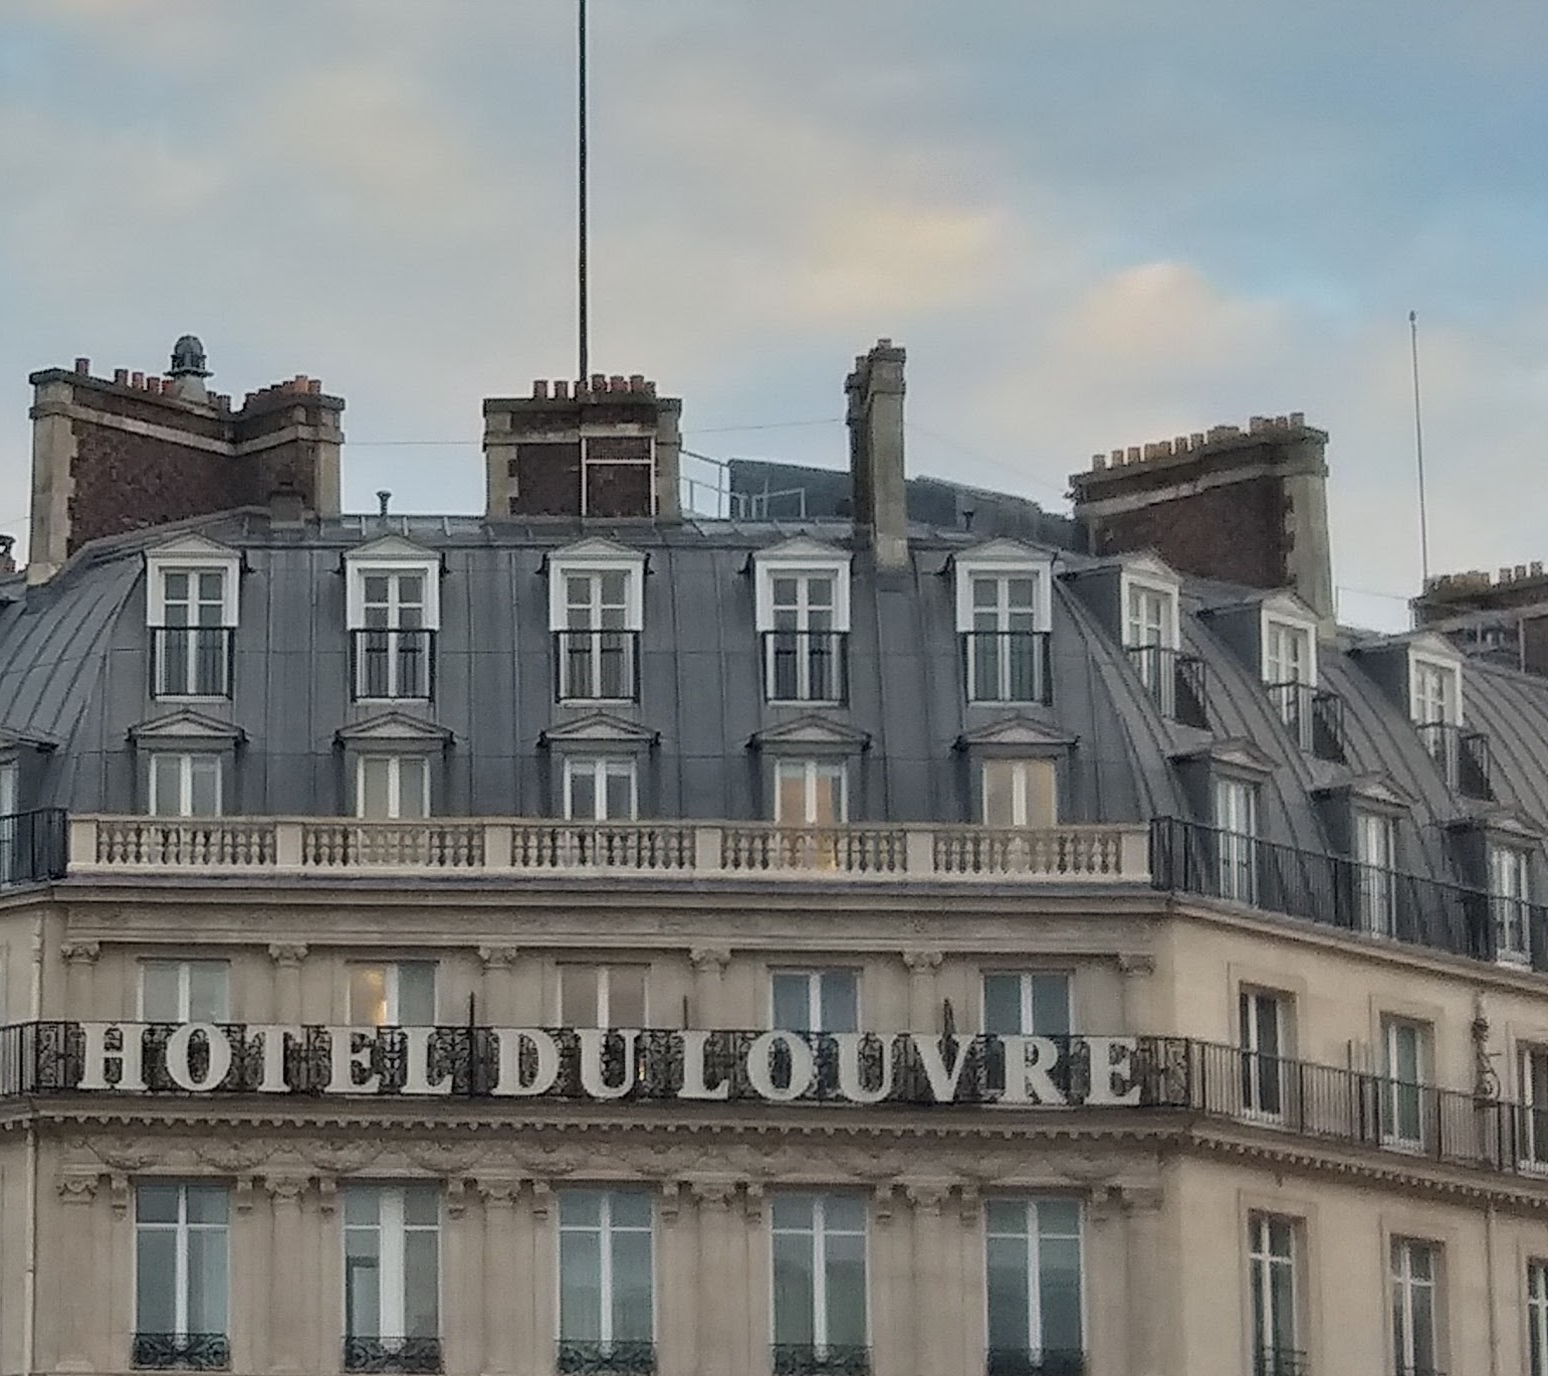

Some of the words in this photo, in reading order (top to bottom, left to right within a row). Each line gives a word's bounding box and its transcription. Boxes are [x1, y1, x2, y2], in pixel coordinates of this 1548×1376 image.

[76, 1022, 453, 1095] HOTEL
[491, 1027, 640, 1100] DU
[676, 1030, 1142, 1106] LOUVRE
